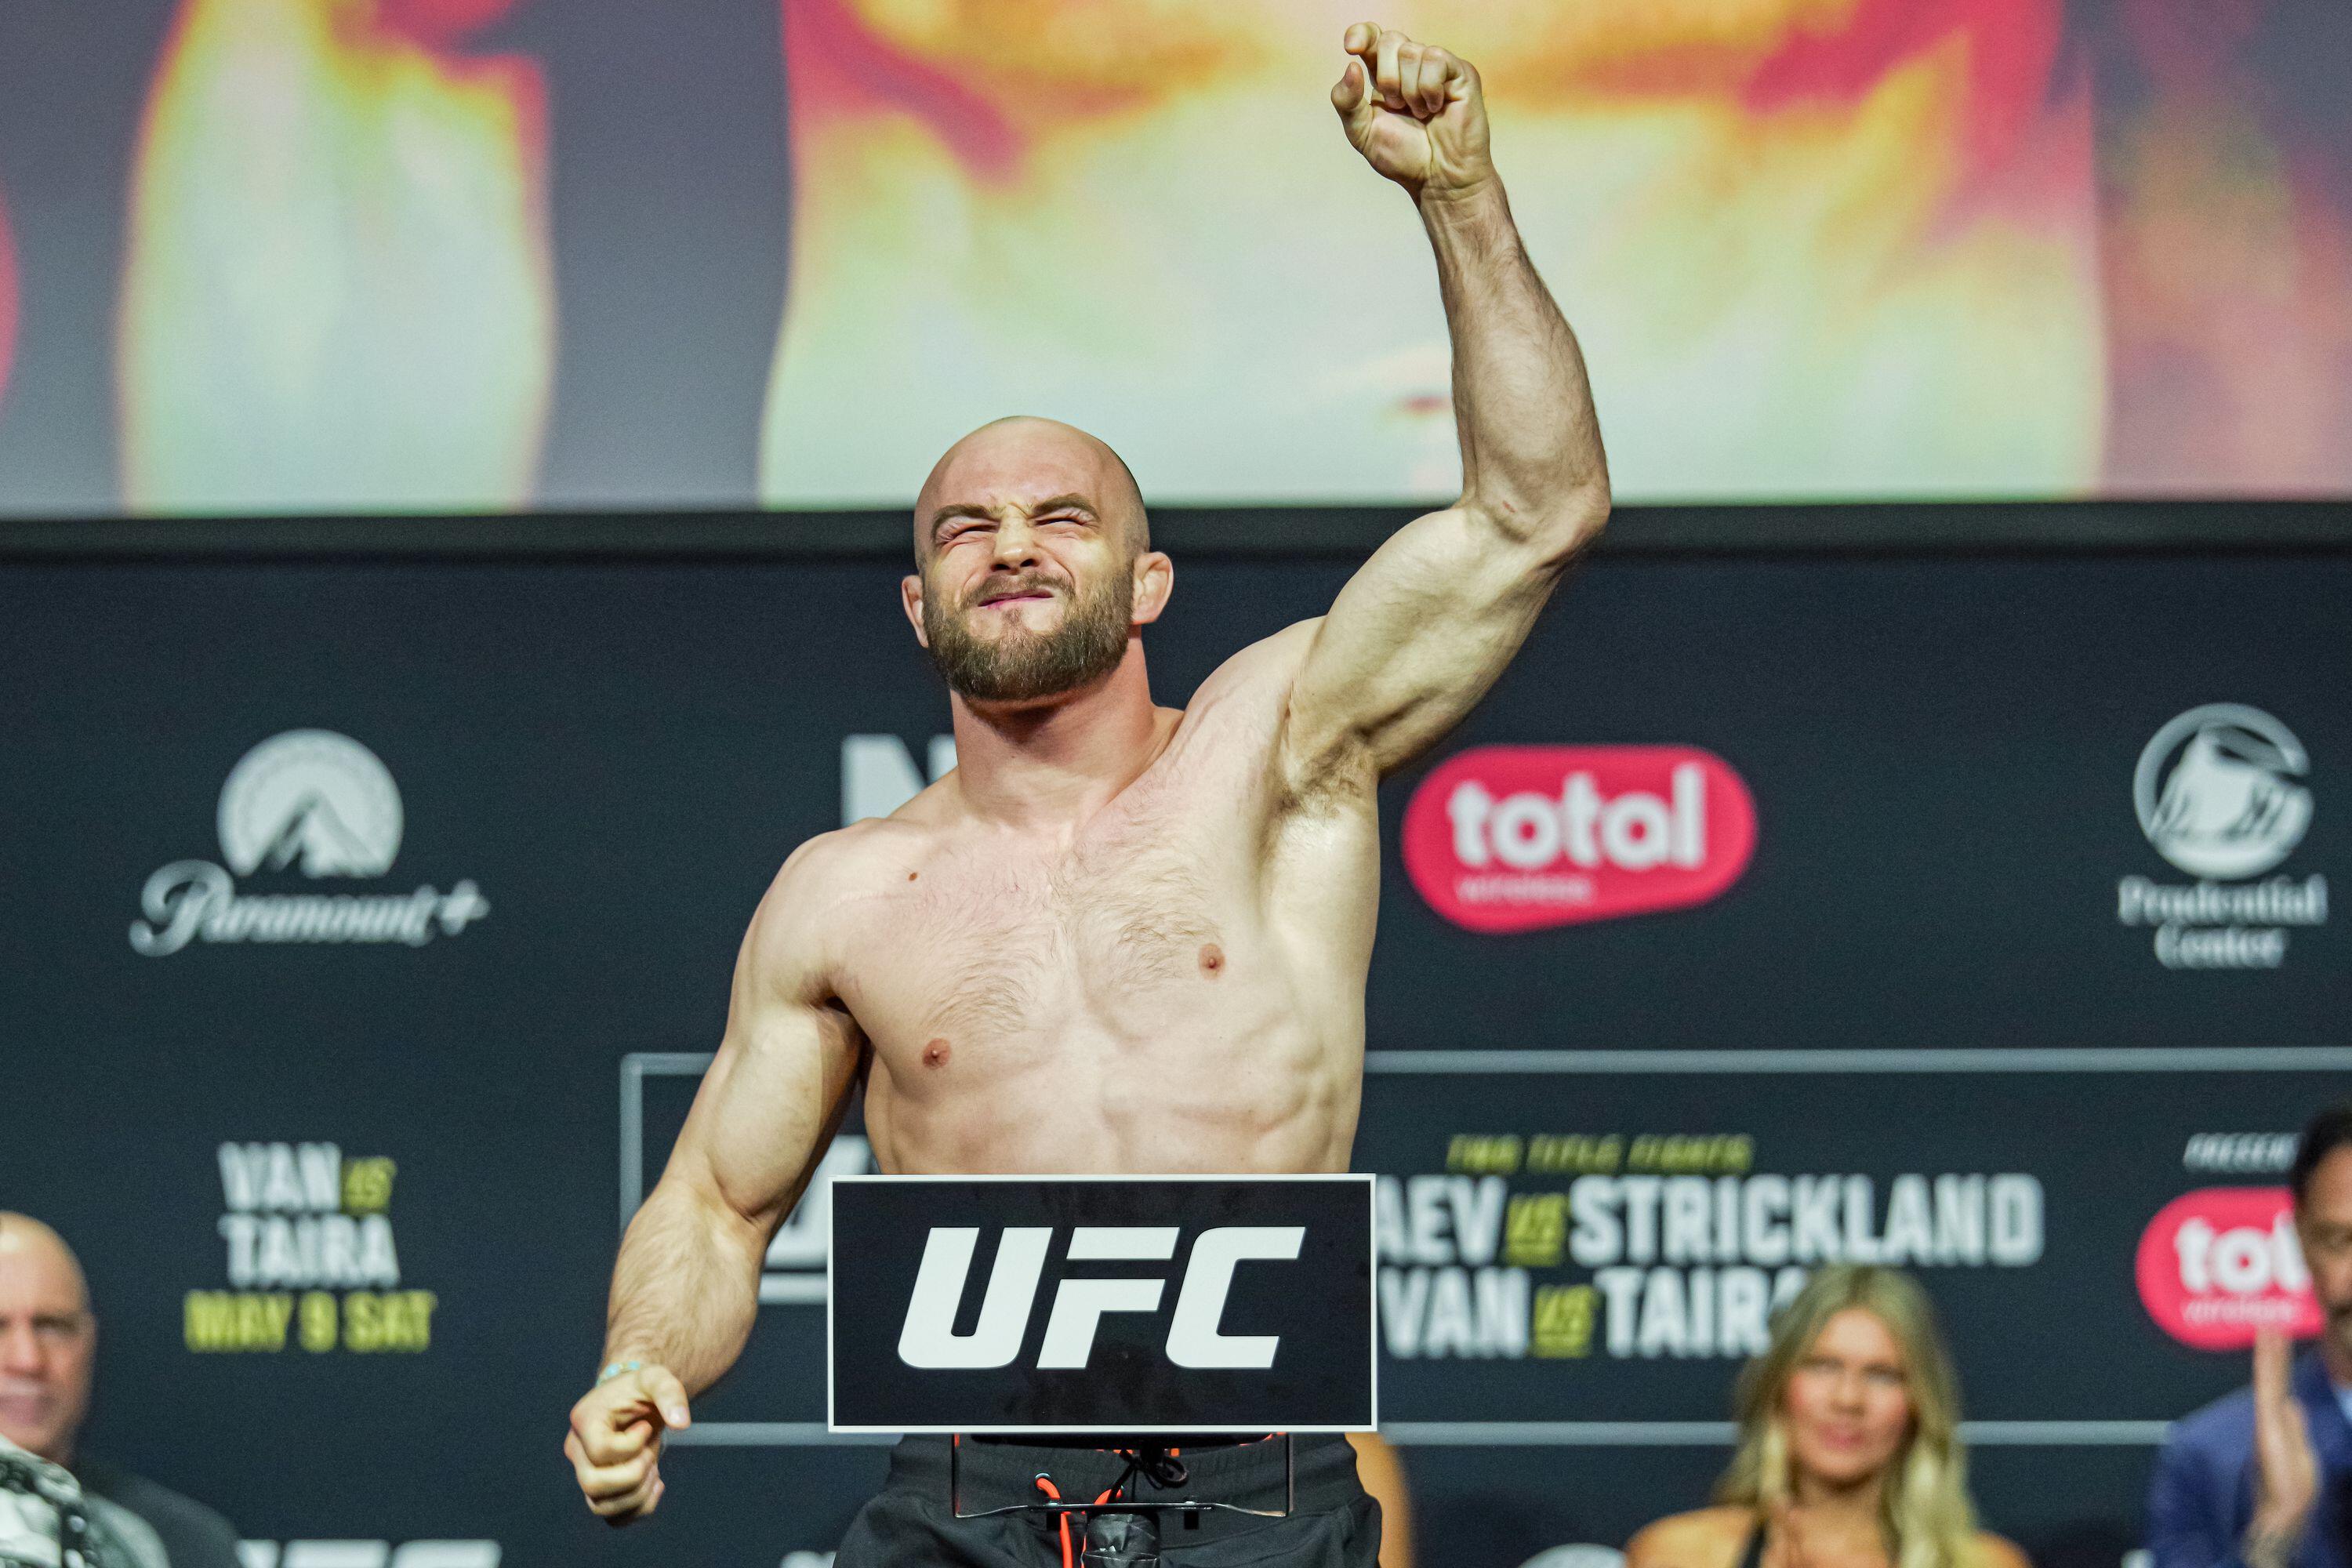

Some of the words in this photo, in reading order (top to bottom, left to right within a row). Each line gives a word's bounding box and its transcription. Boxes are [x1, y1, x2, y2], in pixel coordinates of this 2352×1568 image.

[1447, 764, 1706, 870] total
[129, 860, 489, 956] Paramount+
[218, 1142, 341, 1211] VAN
[1569, 1174, 2045, 1267] STRICKLAND
[217, 1213, 401, 1289] TAIRA
[184, 1290, 293, 1354] MAY
[343, 1290, 438, 1354] SAT
[898, 1227, 1306, 1370] UFC
[1377, 1265, 1530, 1360] VAN
